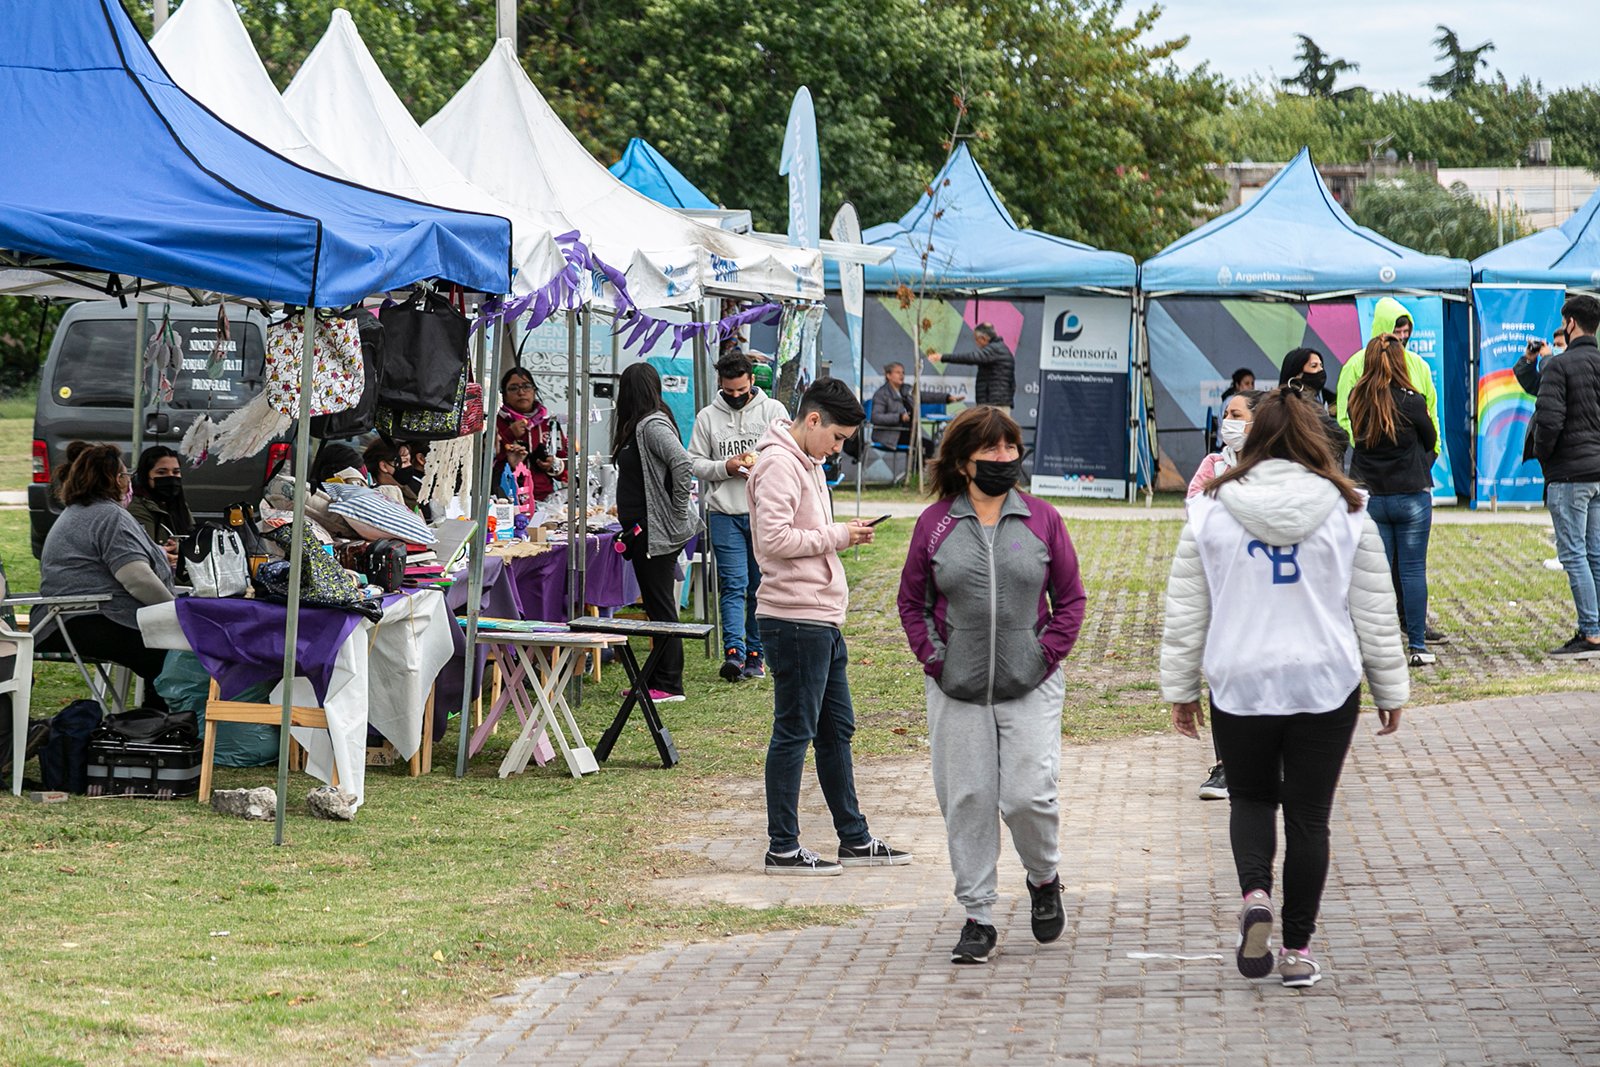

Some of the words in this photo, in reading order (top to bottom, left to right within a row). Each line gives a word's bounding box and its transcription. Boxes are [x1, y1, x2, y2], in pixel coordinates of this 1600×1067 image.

[1235, 271, 1281, 284] Argentina
[1501, 322, 1535, 331] PROYECTO
[1052, 345, 1118, 360] Defensoría
[1409, 340, 1436, 354] gar
[719, 439, 757, 456] HARBO
[927, 515, 952, 554] adida
